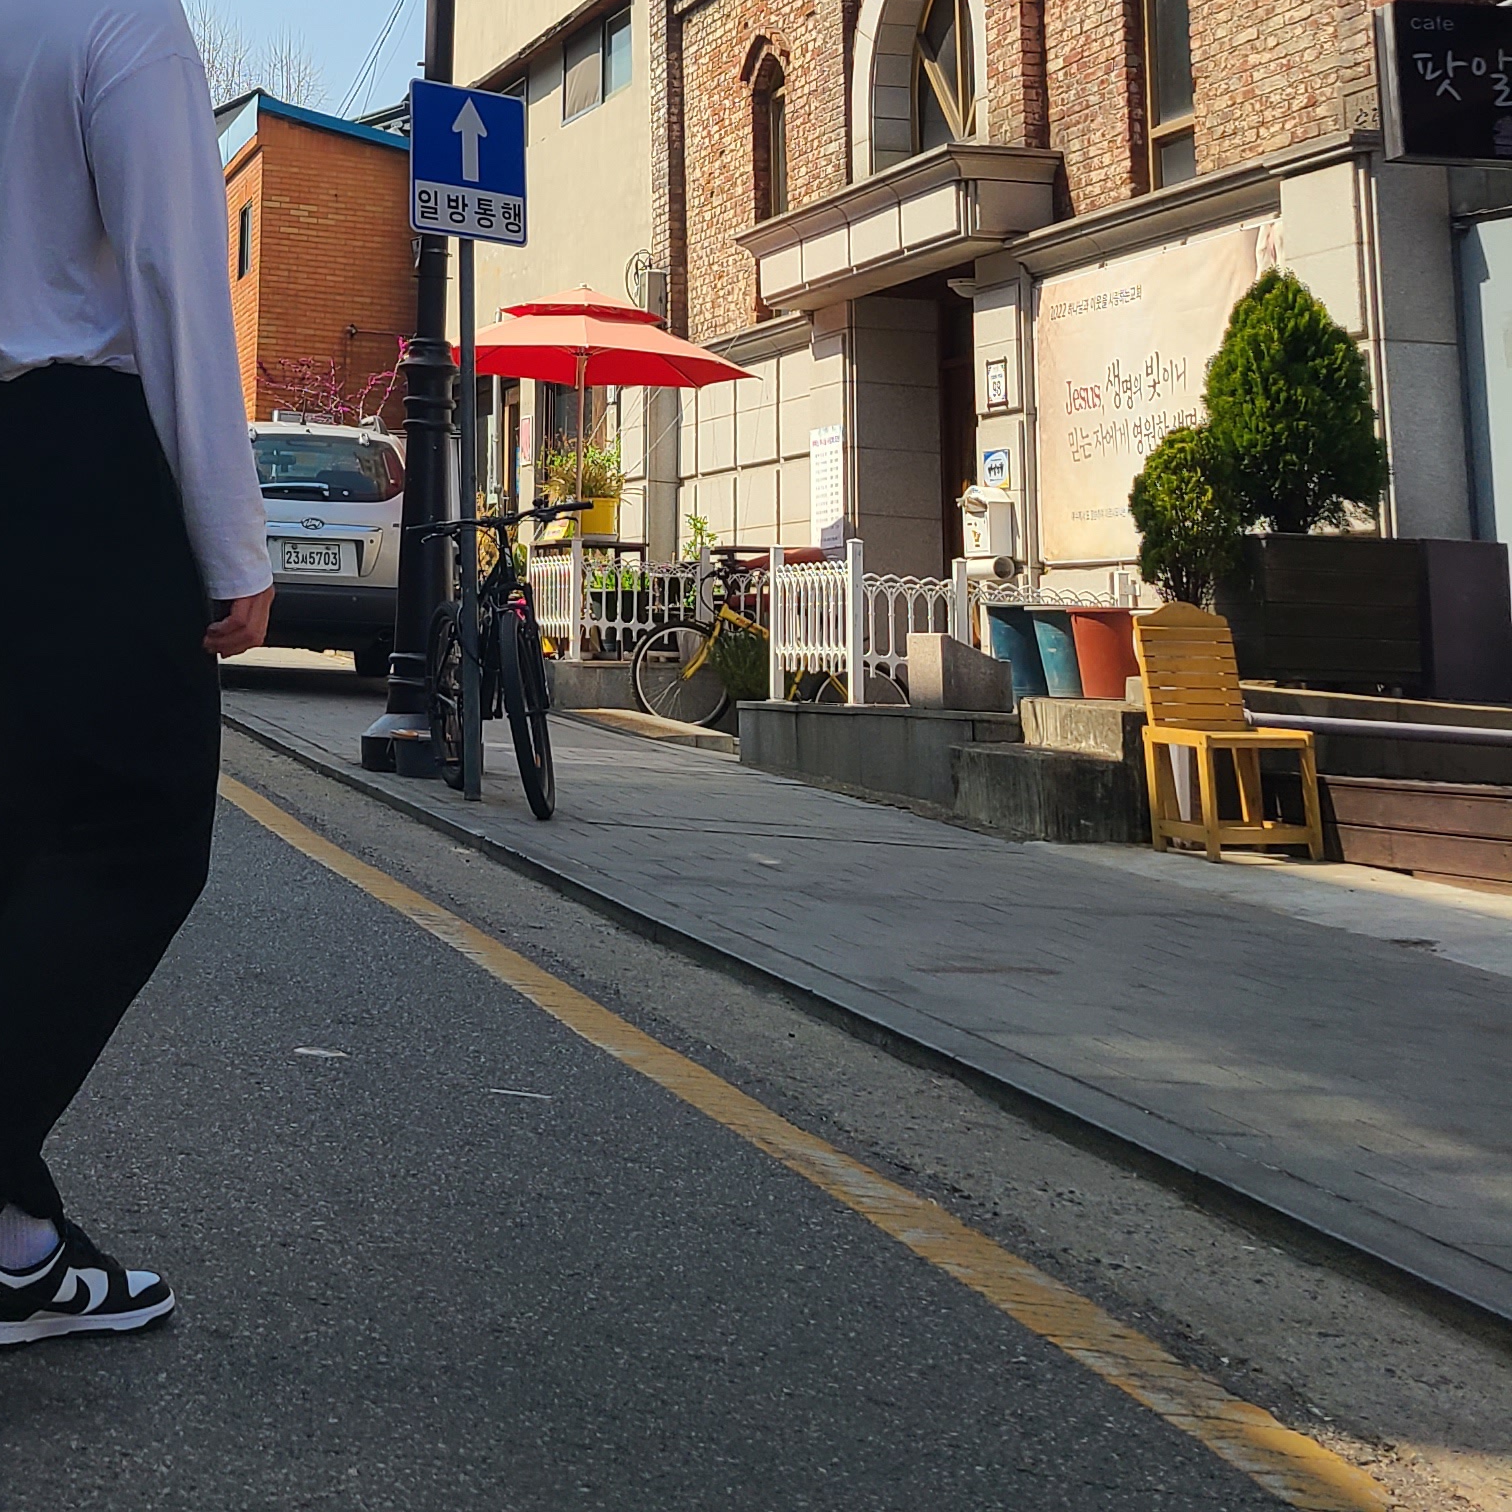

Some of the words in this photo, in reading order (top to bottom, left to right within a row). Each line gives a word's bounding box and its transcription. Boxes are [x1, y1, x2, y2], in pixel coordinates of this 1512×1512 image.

[1410, 15, 1455, 32] cafe
[1412, 48, 1512, 108] 팟알
[418, 189, 522, 234] 일방통행
[1050, 302, 1067, 321] 2022
[1065, 380, 1105, 416] Jesus,
[1105, 358, 1143, 410] 생명의
[1144, 350, 1187, 402] 빛이니
